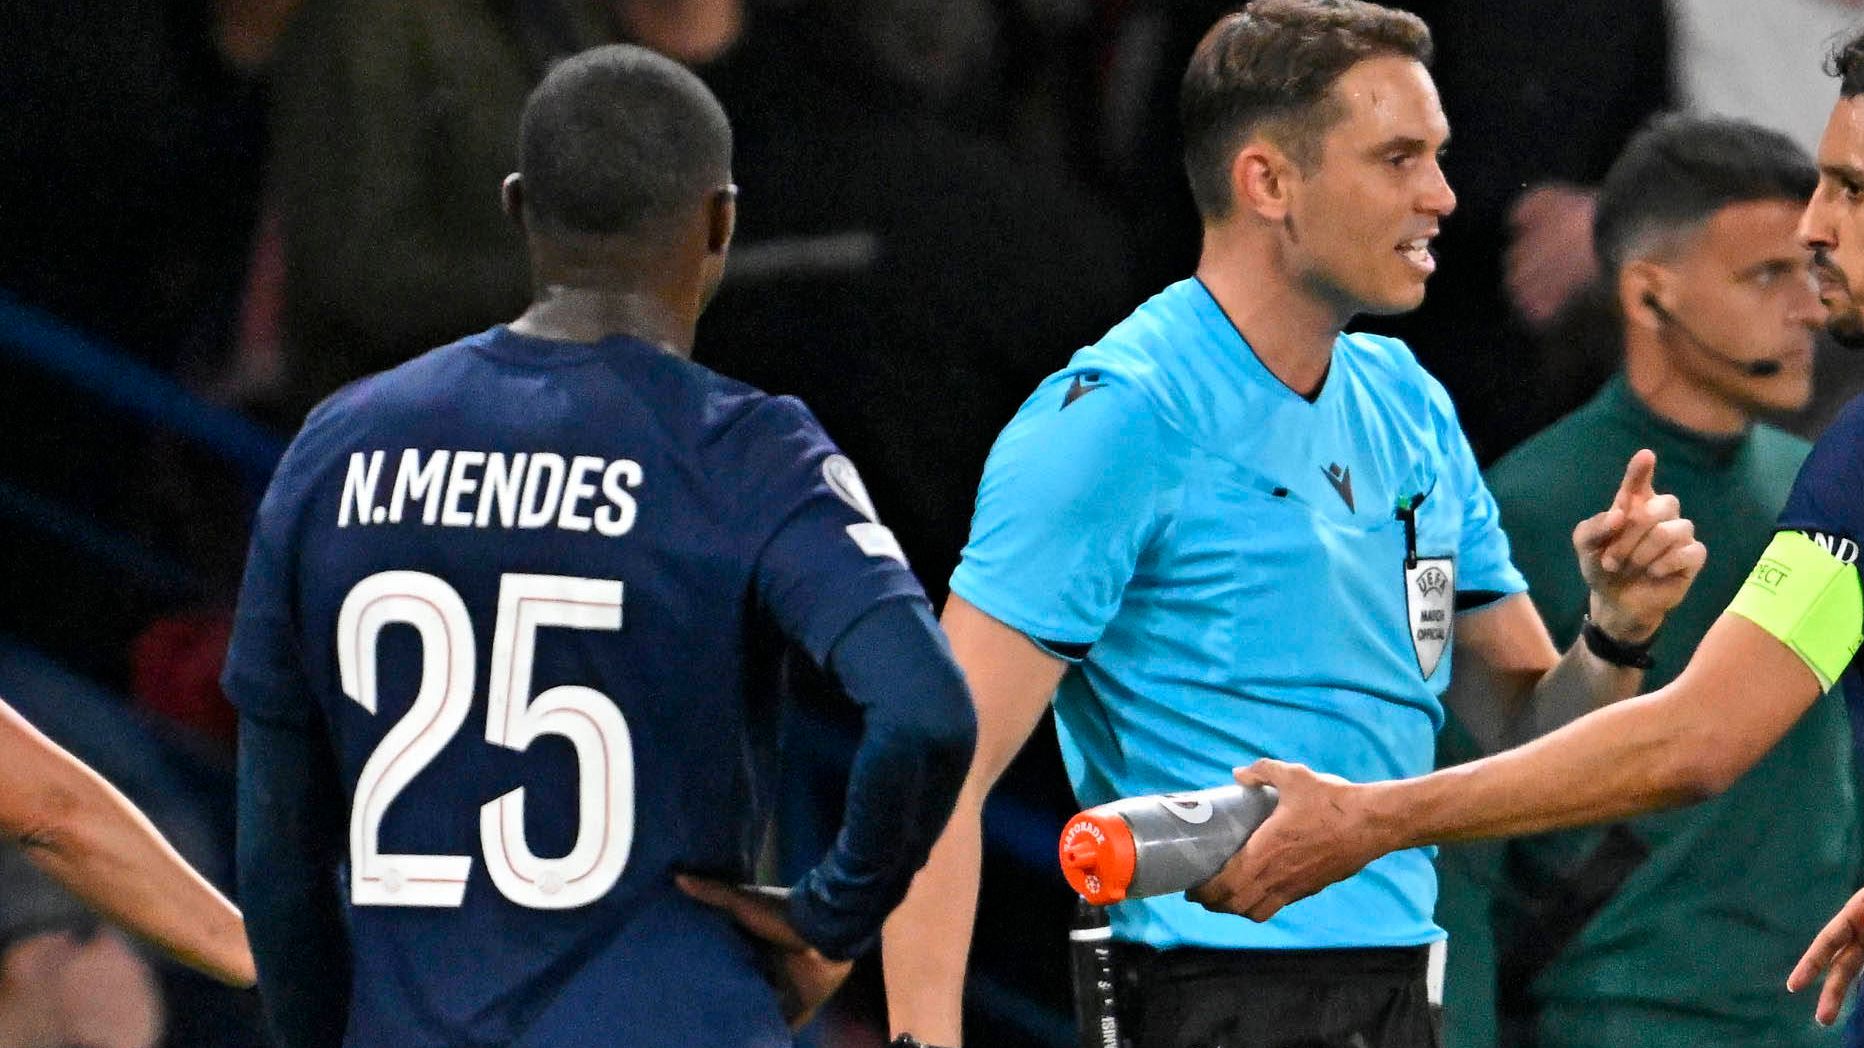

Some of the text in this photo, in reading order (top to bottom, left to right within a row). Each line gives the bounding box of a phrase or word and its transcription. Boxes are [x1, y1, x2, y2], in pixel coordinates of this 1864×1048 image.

[337, 448, 643, 536] N.MENDES
[1418, 570, 1447, 593] UEFA
[337, 570, 635, 909] 25
